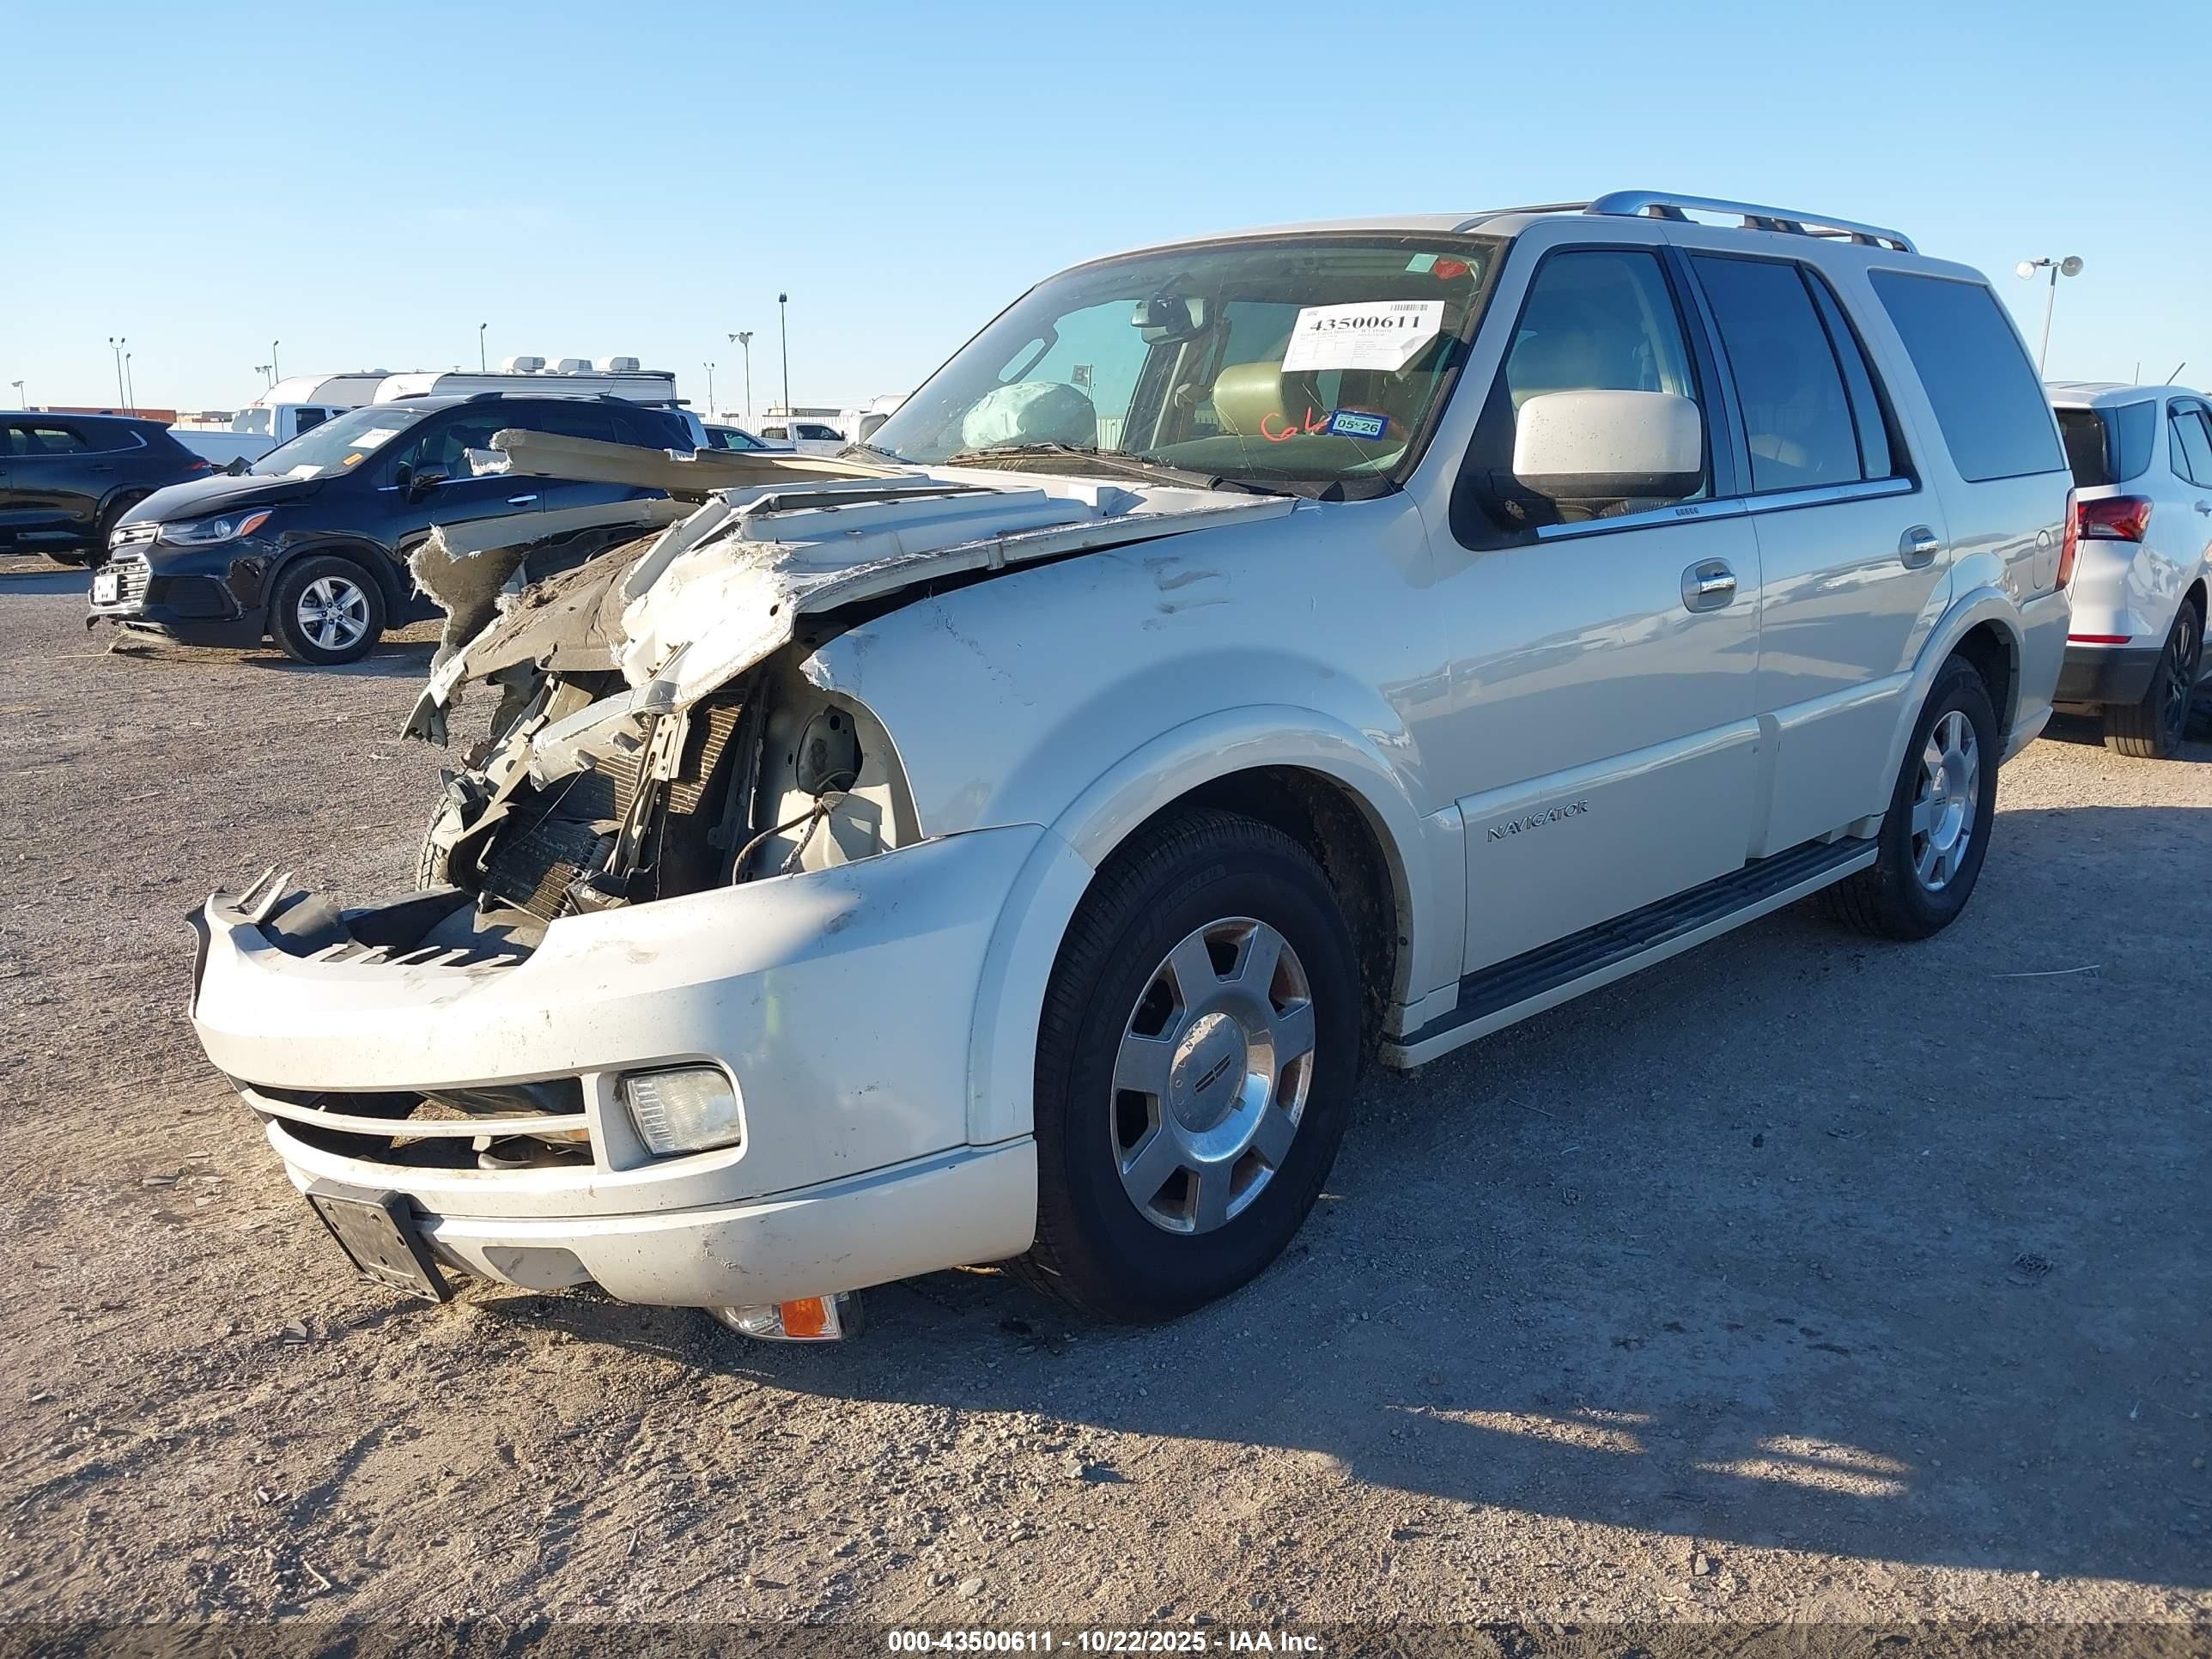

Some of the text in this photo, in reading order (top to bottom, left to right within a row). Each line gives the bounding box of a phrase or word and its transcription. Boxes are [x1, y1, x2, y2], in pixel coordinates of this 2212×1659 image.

[1310, 315, 1420, 331] 43500611
[1338, 419, 1355, 429] 05
[1360, 422, 1379, 433] 26
[1487, 799, 1588, 842] NAVIGATOR
